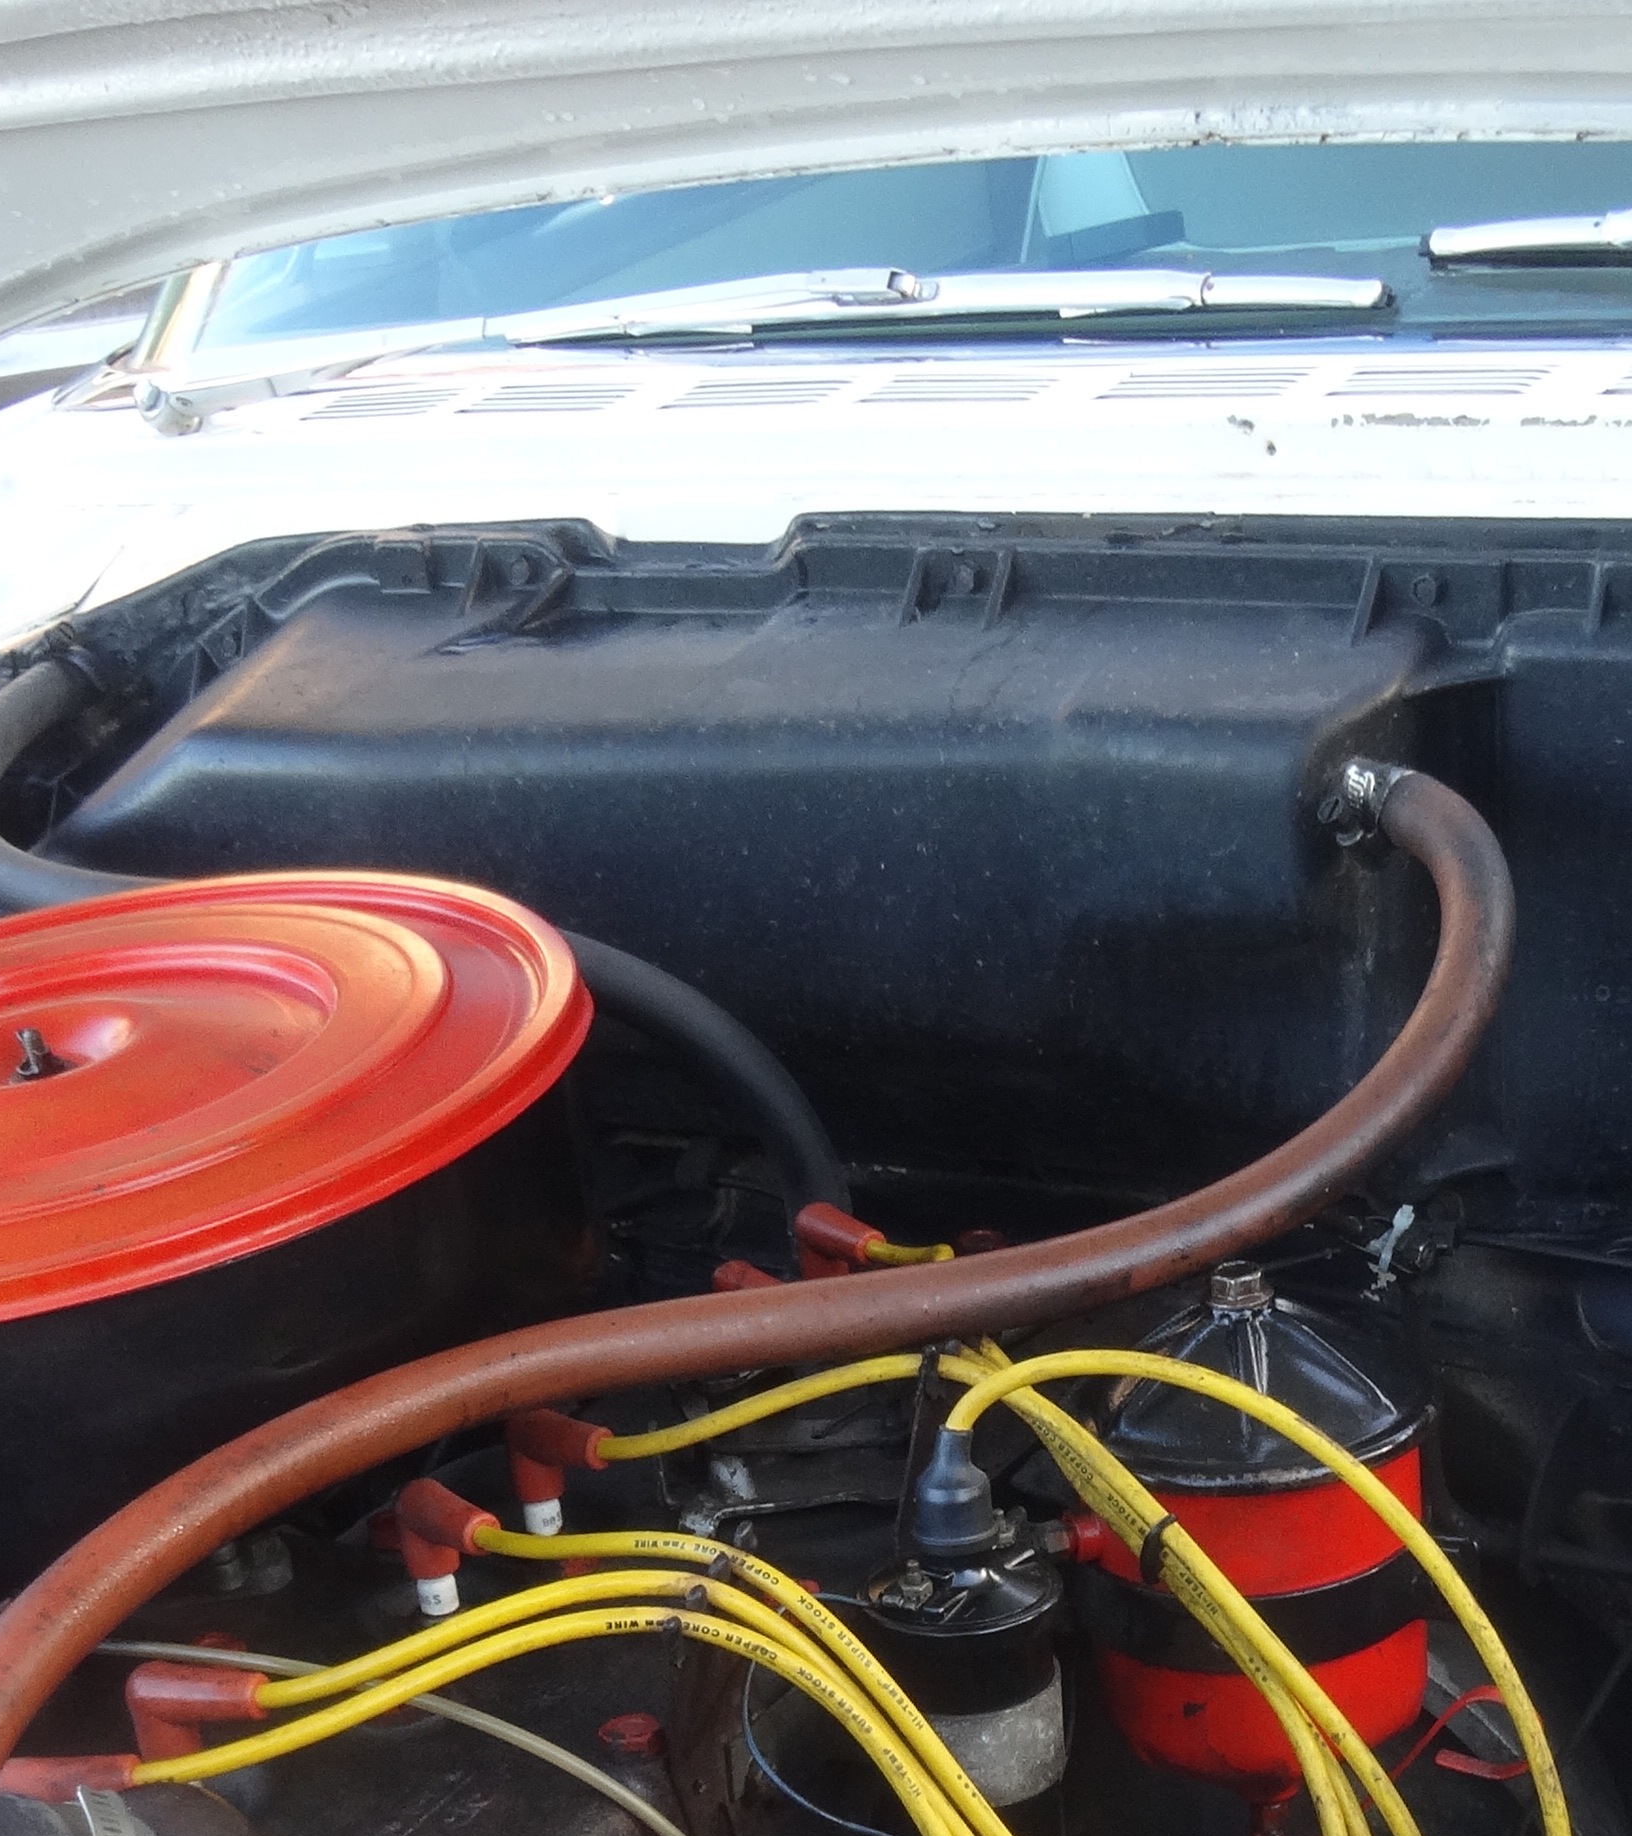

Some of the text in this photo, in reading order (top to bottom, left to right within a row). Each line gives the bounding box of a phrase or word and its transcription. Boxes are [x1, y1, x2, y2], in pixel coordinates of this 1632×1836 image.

[634, 1538, 659, 1549] WIRE
[731, 1553, 780, 1586] COPPER
[605, 1618, 640, 1632] WIRE
[796, 1595, 836, 1630] STOCK
[724, 1632, 778, 1661] COPPER
[796, 1666, 838, 1699] STOCK
